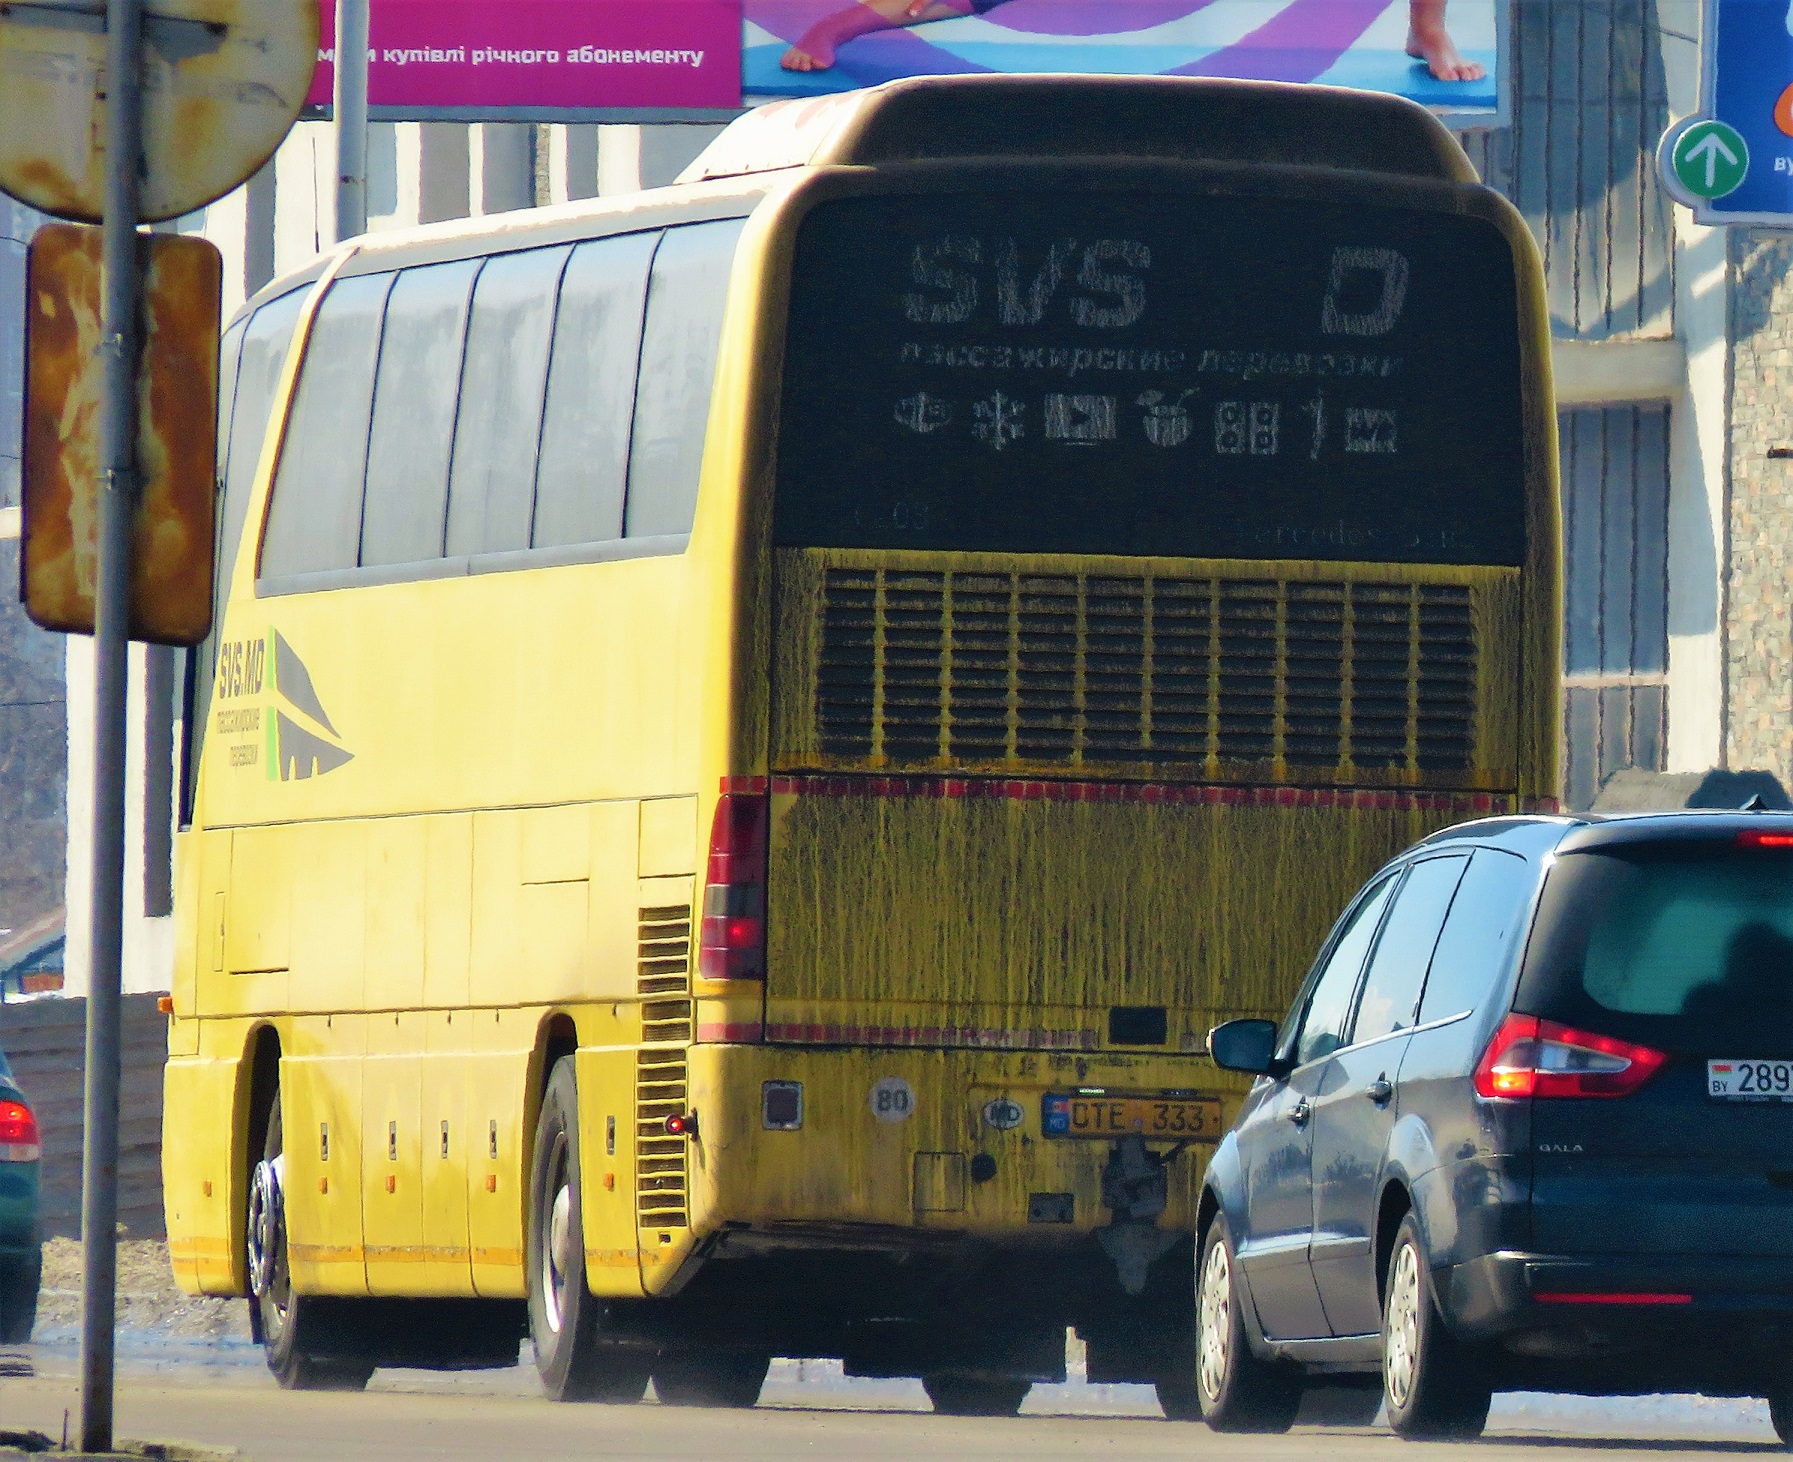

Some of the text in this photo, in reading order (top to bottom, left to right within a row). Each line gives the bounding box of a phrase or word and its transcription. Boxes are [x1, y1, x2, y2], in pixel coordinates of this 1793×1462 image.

[383, 46, 465, 66] купівлі
[471, 46, 560, 65] річного
[566, 45, 704, 67] абонементу
[903, 235, 1151, 328] SVS
[219, 638, 265, 700] SVS.MD
[1712, 1063, 1793, 1093] BY 289
[876, 1089, 909, 1112] 80
[1048, 1118, 1066, 1130] MD
[1152, 1103, 1205, 1131] 333
